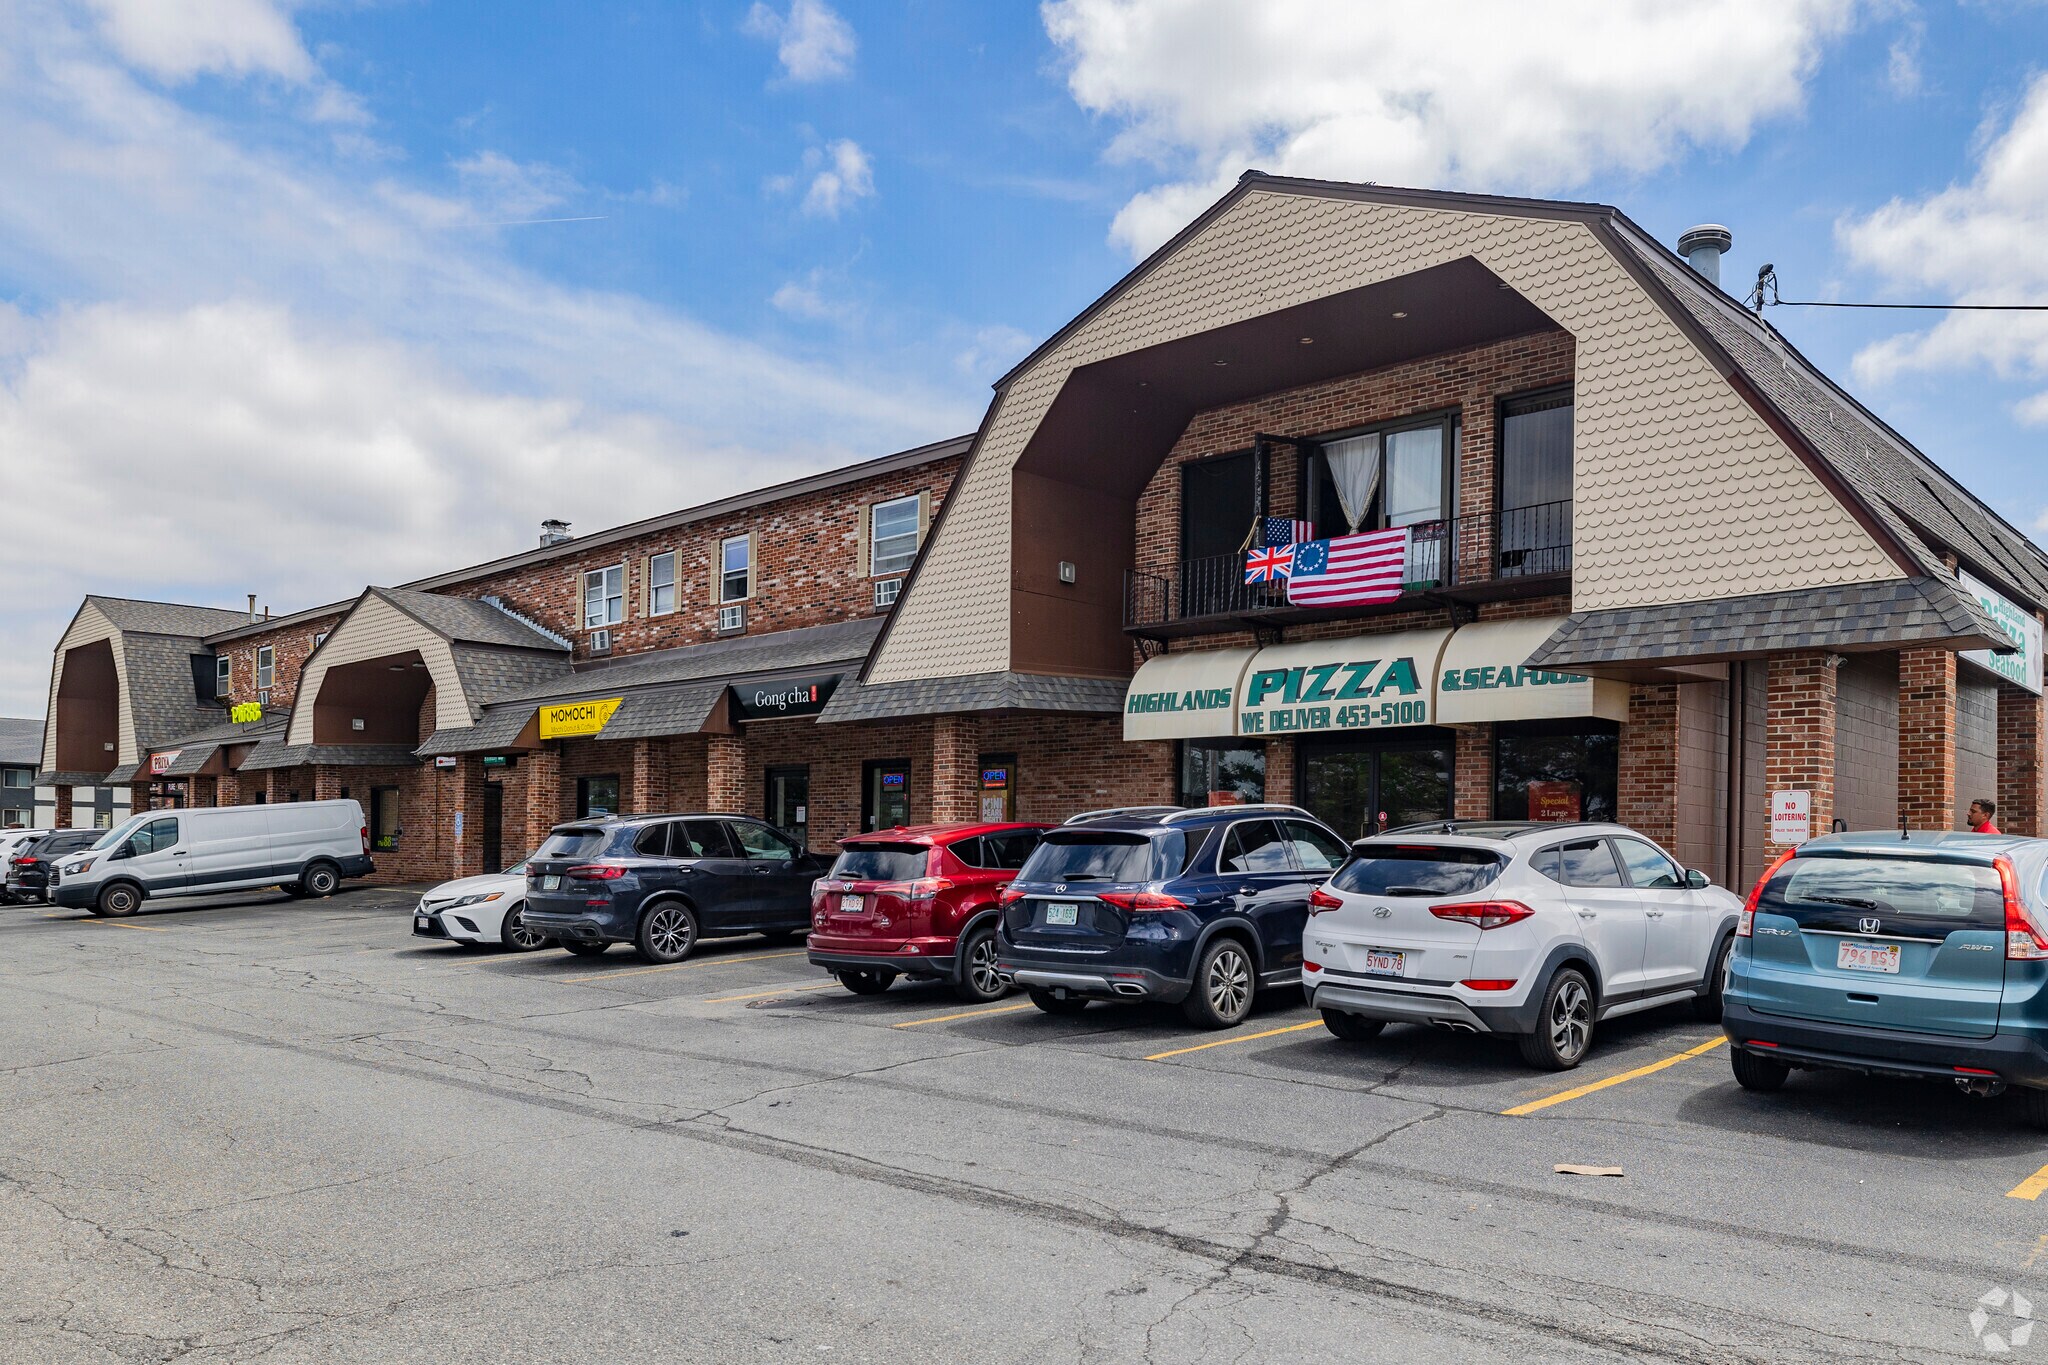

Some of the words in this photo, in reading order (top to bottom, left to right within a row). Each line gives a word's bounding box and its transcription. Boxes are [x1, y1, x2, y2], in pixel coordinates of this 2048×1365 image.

[1127, 688, 1232, 714] HIGHLANDS
[1246, 657, 1422, 707] PIZZA
[755, 690, 786, 710] Gong
[788, 686, 810, 704] cha
[550, 706, 595, 723] MOMOCHI
[1241, 711, 1264, 733] WE
[1270, 706, 1331, 732] DELIVER
[1336, 700, 1426, 728] 453-5100
[883, 775, 903, 785] OPEN
[984, 771, 1006, 780] OPEN
[982, 797, 1003, 809] MINI
[1540, 796, 1569, 808] Special
[1785, 802, 1796, 810] NO
[1547, 810, 1569, 818] Large
[1774, 813, 1807, 821] LOITERING
[1958, 943, 1994, 951] AWD
[1840, 948, 1867, 964] 796
[1367, 956, 1389, 969] 5YND
[1391, 958, 1403, 971] 78
